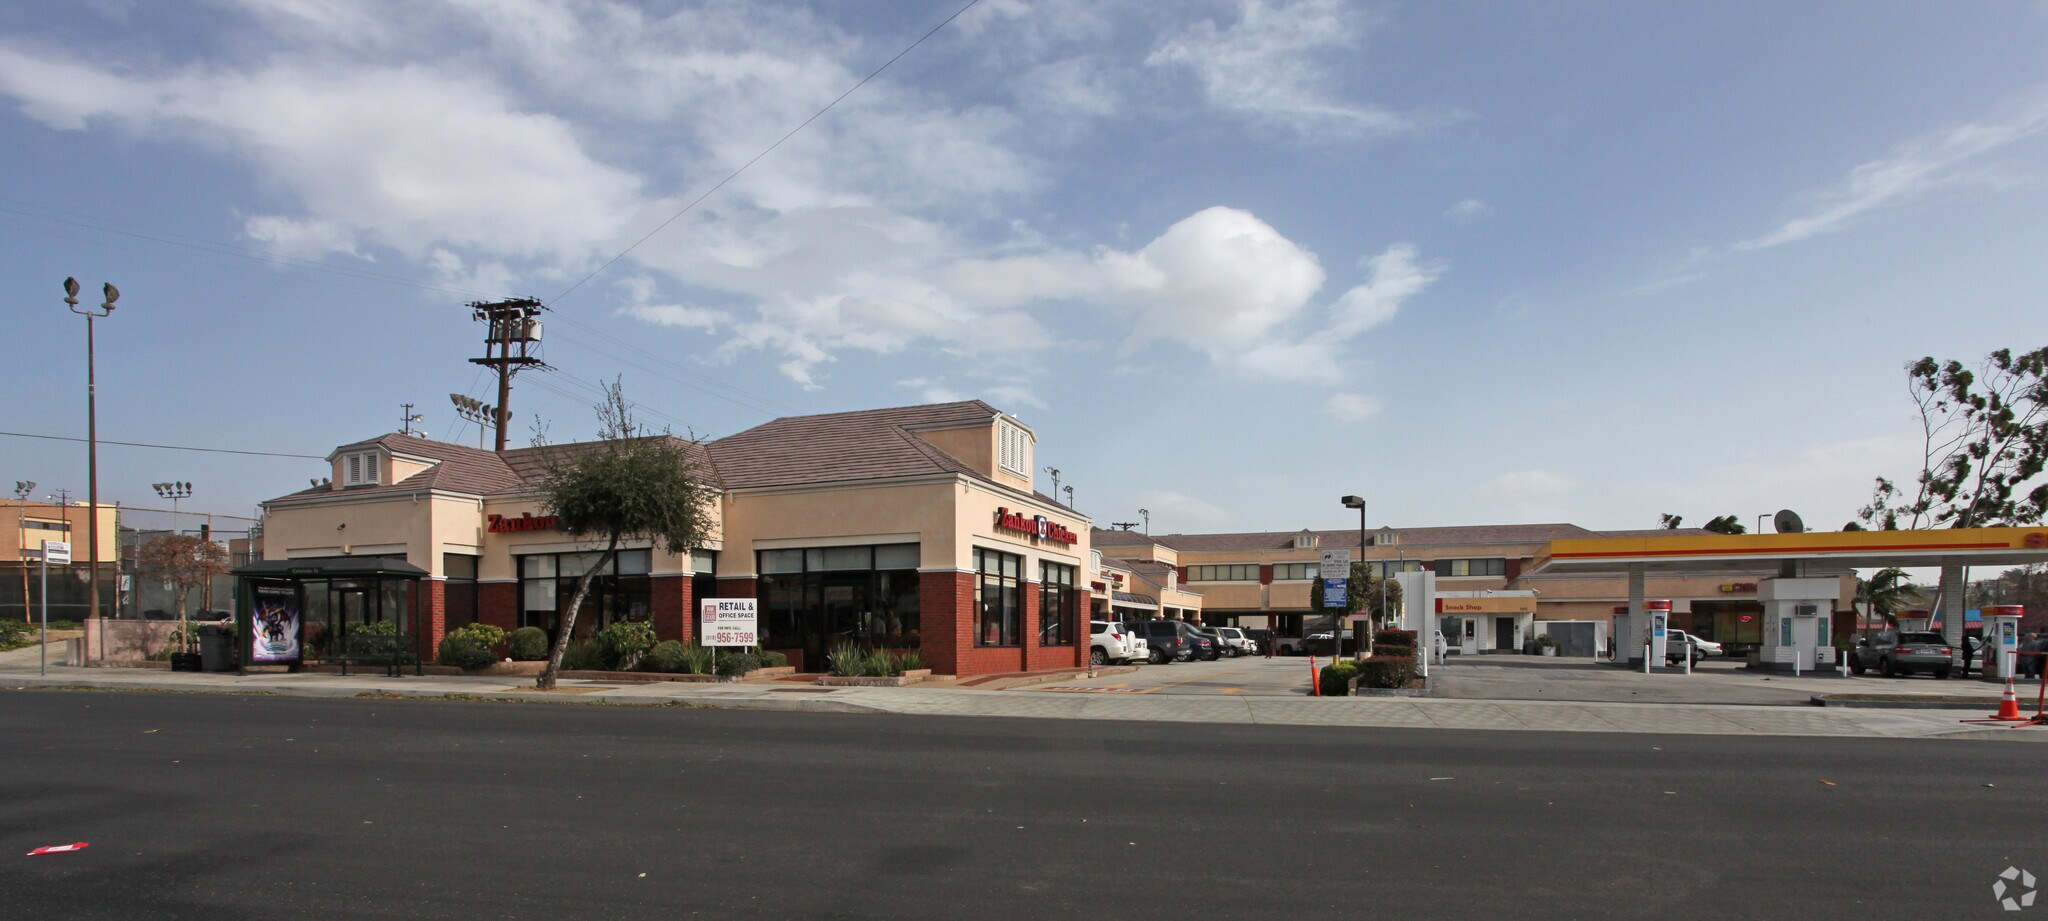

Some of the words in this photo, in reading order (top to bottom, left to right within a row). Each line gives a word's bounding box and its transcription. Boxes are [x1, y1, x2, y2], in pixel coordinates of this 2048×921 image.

[488, 512, 558, 533] Zankou
[998, 507, 1037, 534] Zankou
[1048, 521, 1078, 545] Chicken
[719, 602, 746, 610] RETAIL
[1465, 604, 1482, 612] Shop
[717, 632, 753, 643] 956-7599
